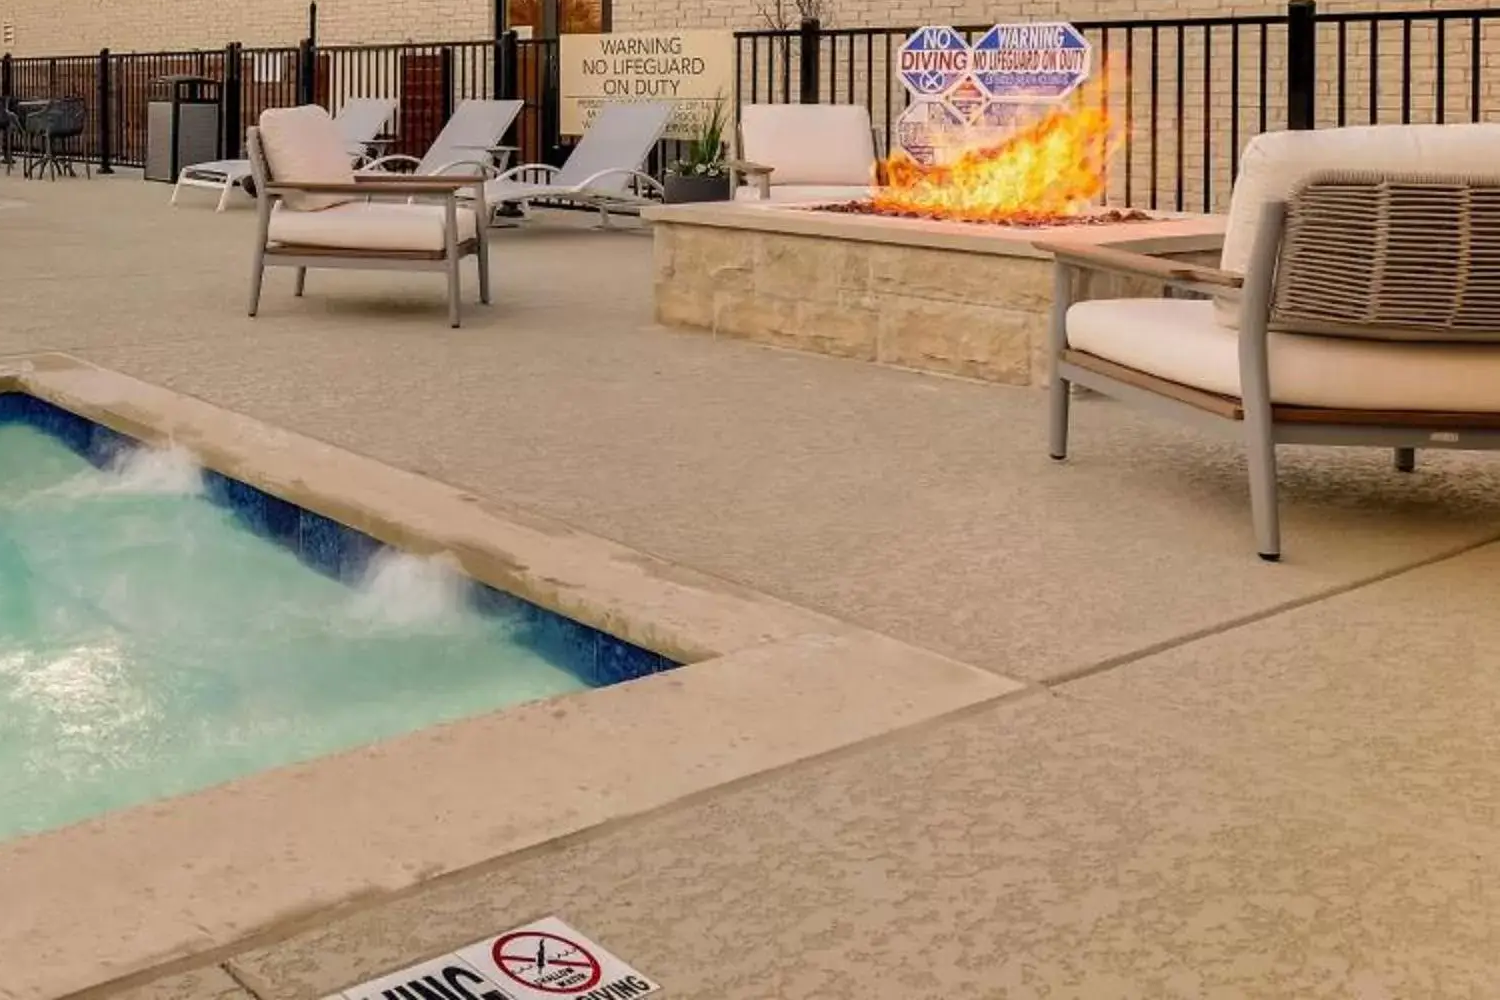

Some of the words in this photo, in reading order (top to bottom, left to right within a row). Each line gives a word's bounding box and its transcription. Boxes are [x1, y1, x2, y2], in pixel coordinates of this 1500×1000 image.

[600, 37, 683, 55] WARNING
[923, 28, 952, 49] NO
[998, 26, 1065, 48] WARNING
[582, 59, 608, 75] NO
[613, 57, 705, 75] LIFEGUARD
[901, 51, 968, 70] DIVING
[973, 52, 987, 70] NO
[989, 51, 1040, 71] LIFEGUARD
[1041, 51, 1057, 70] ON
[1059, 50, 1086, 70] DUTY
[603, 79, 629, 95] ON
[635, 79, 681, 96] DUTY
